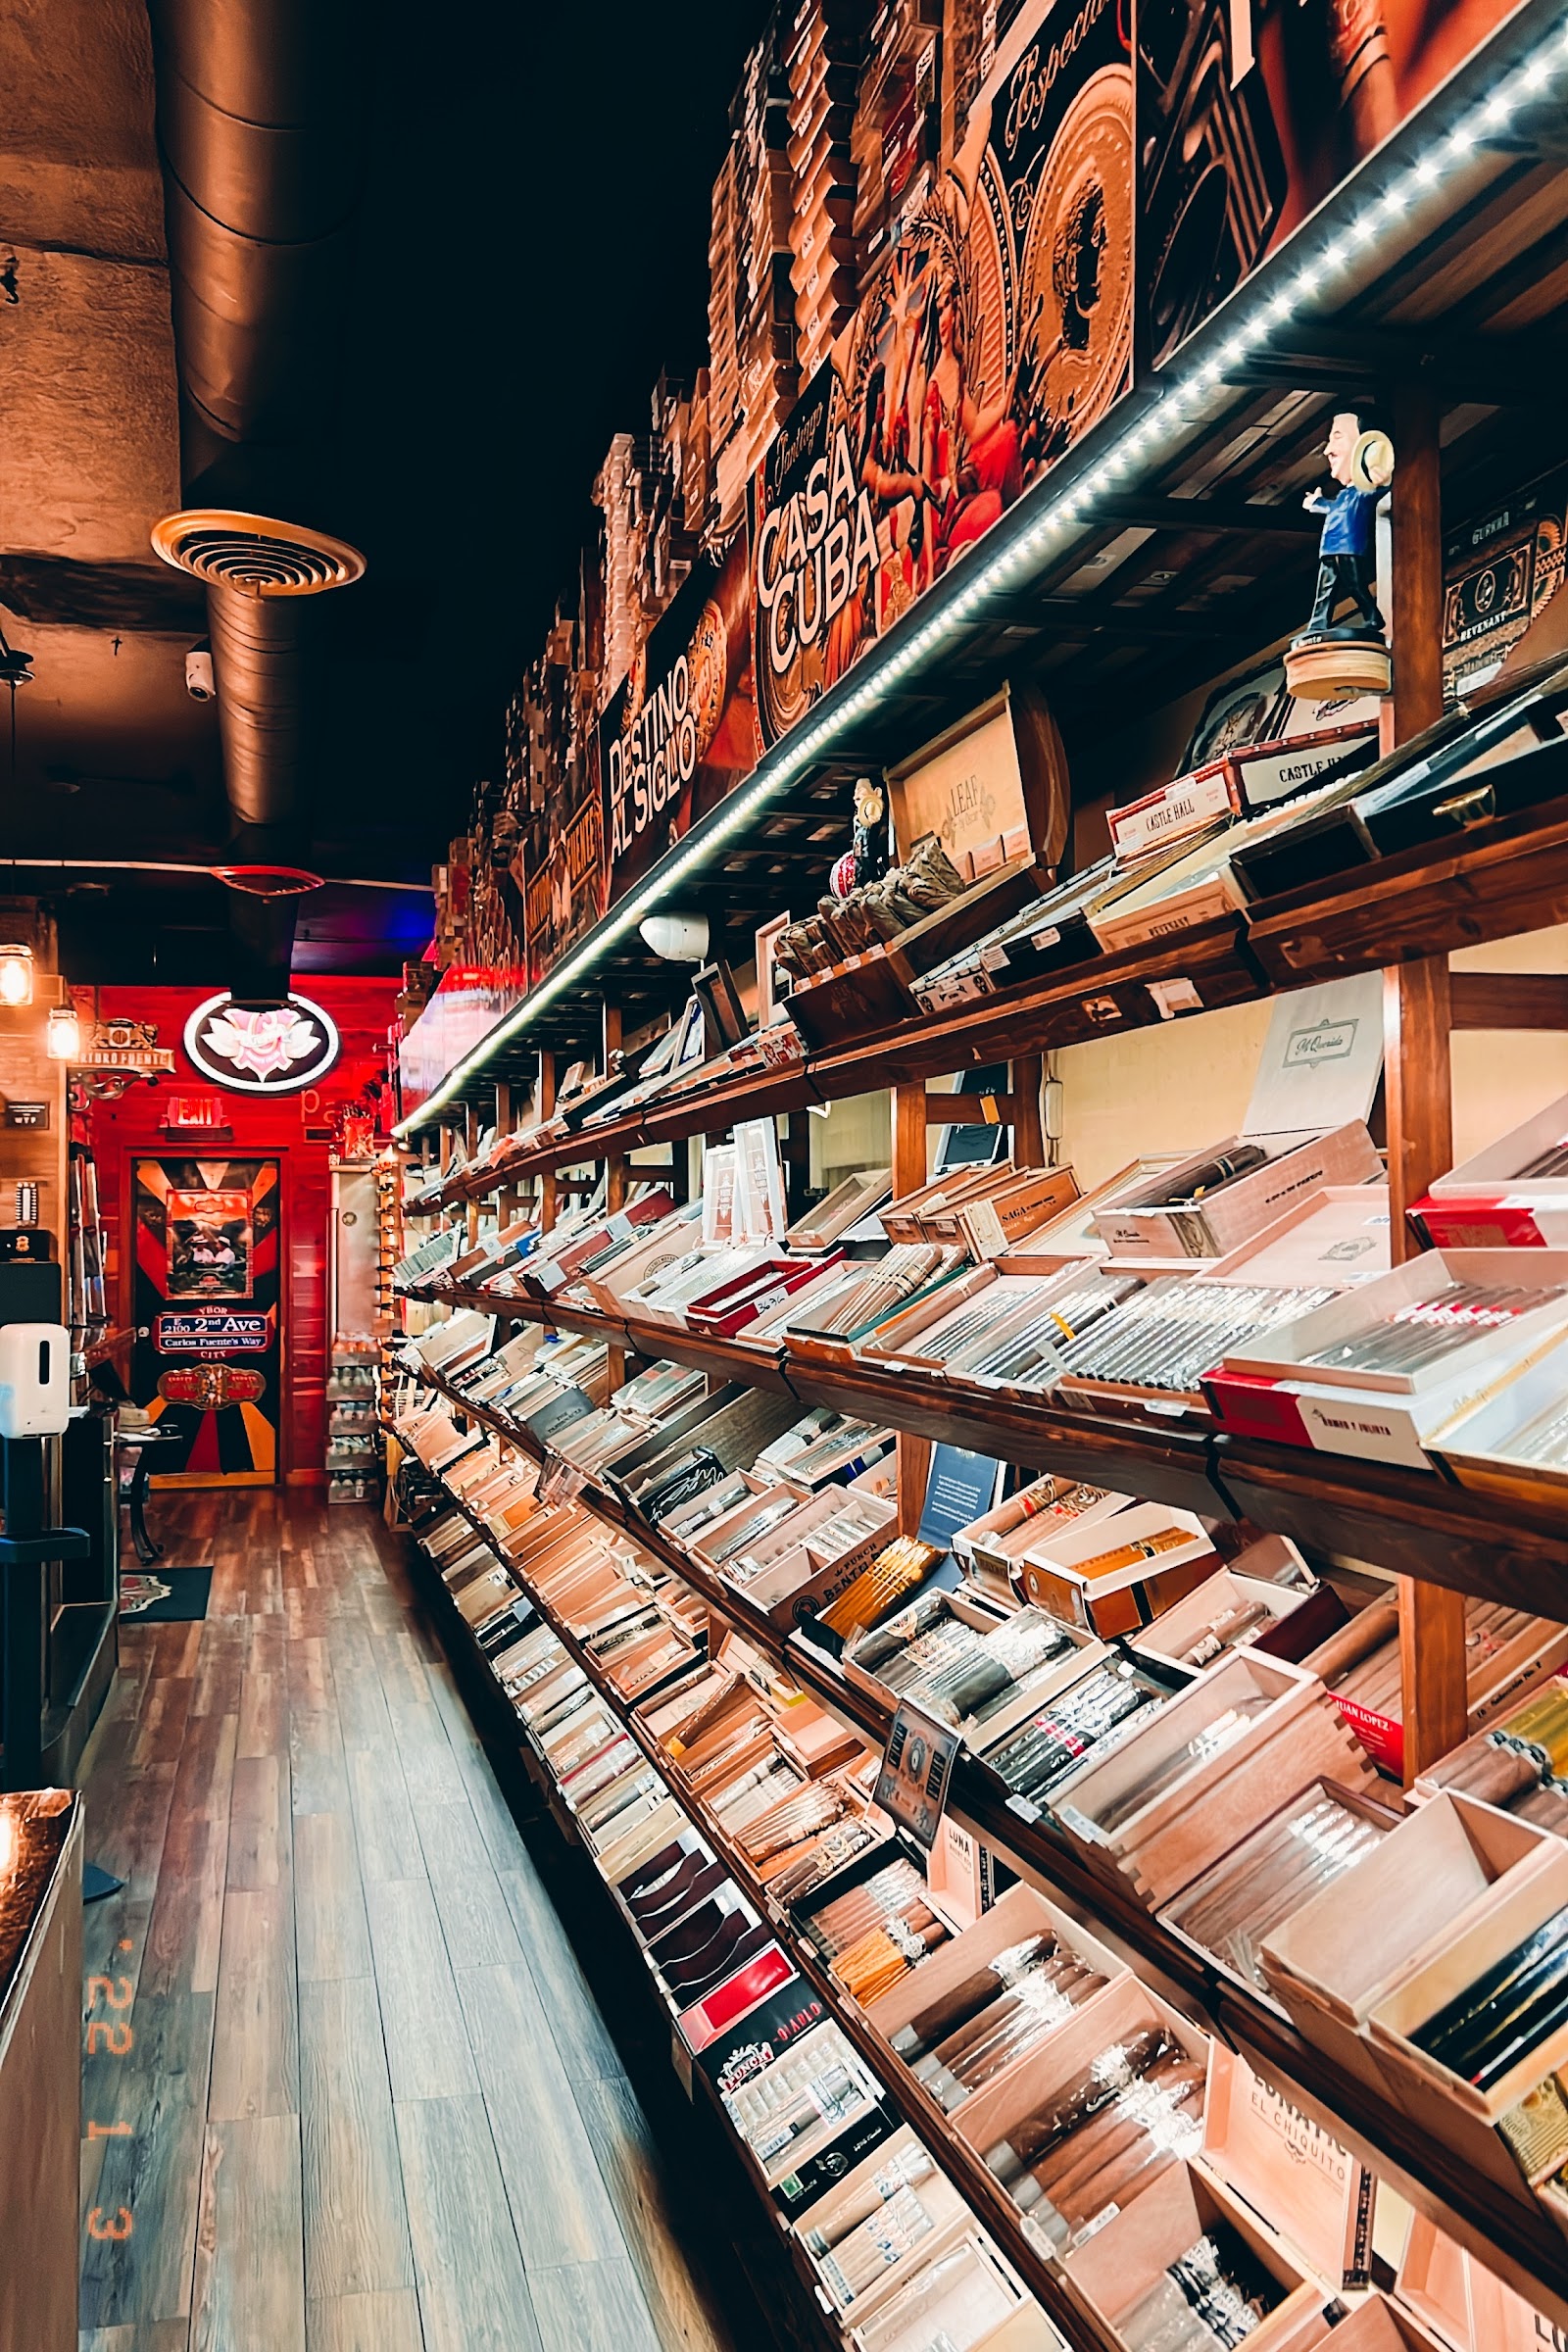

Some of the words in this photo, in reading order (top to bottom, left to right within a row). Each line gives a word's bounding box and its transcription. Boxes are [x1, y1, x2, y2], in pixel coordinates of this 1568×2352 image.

[758, 424, 857, 608] CASA
[1472, 512, 1510, 545] GURKHA
[770, 486, 880, 673] CUBA
[1460, 610, 1507, 642] REVENANT
[608, 655, 689, 809] DESTINO
[634, 713, 696, 834] SIGLO
[1279, 760, 1325, 783] CASTLE
[950, 774, 978, 816] LEAF
[1146, 807, 1173, 833] CASTLE
[1173, 799, 1196, 821] HALL
[611, 808, 633, 865] AL
[121, 1052, 168, 1066] FUENTE
[177, 1098, 214, 1125] EXIT
[1002, 1206, 1027, 1223] SAGA
[195, 1317, 221, 1332] 2nd
[221, 1317, 262, 1332] Ave
[199, 1305, 228, 1315] YBOR
[165, 1338, 197, 1348] Carlos
[199, 1338, 239, 1347] Fuente's
[240, 1338, 262, 1347] Way
[200, 1349, 227, 1359] CITY
[844, 1543, 877, 1569] PUNCH
[1336, 1699, 1359, 1718] JUAN
[1359, 1710, 1390, 1732] LOPEZ
[949, 1827, 970, 1856] LUNA
[725, 2050, 772, 2090] PUNCH
[1251, 2092, 1267, 2115] EL
[1273, 2112, 1346, 2180] CHIQUITO
